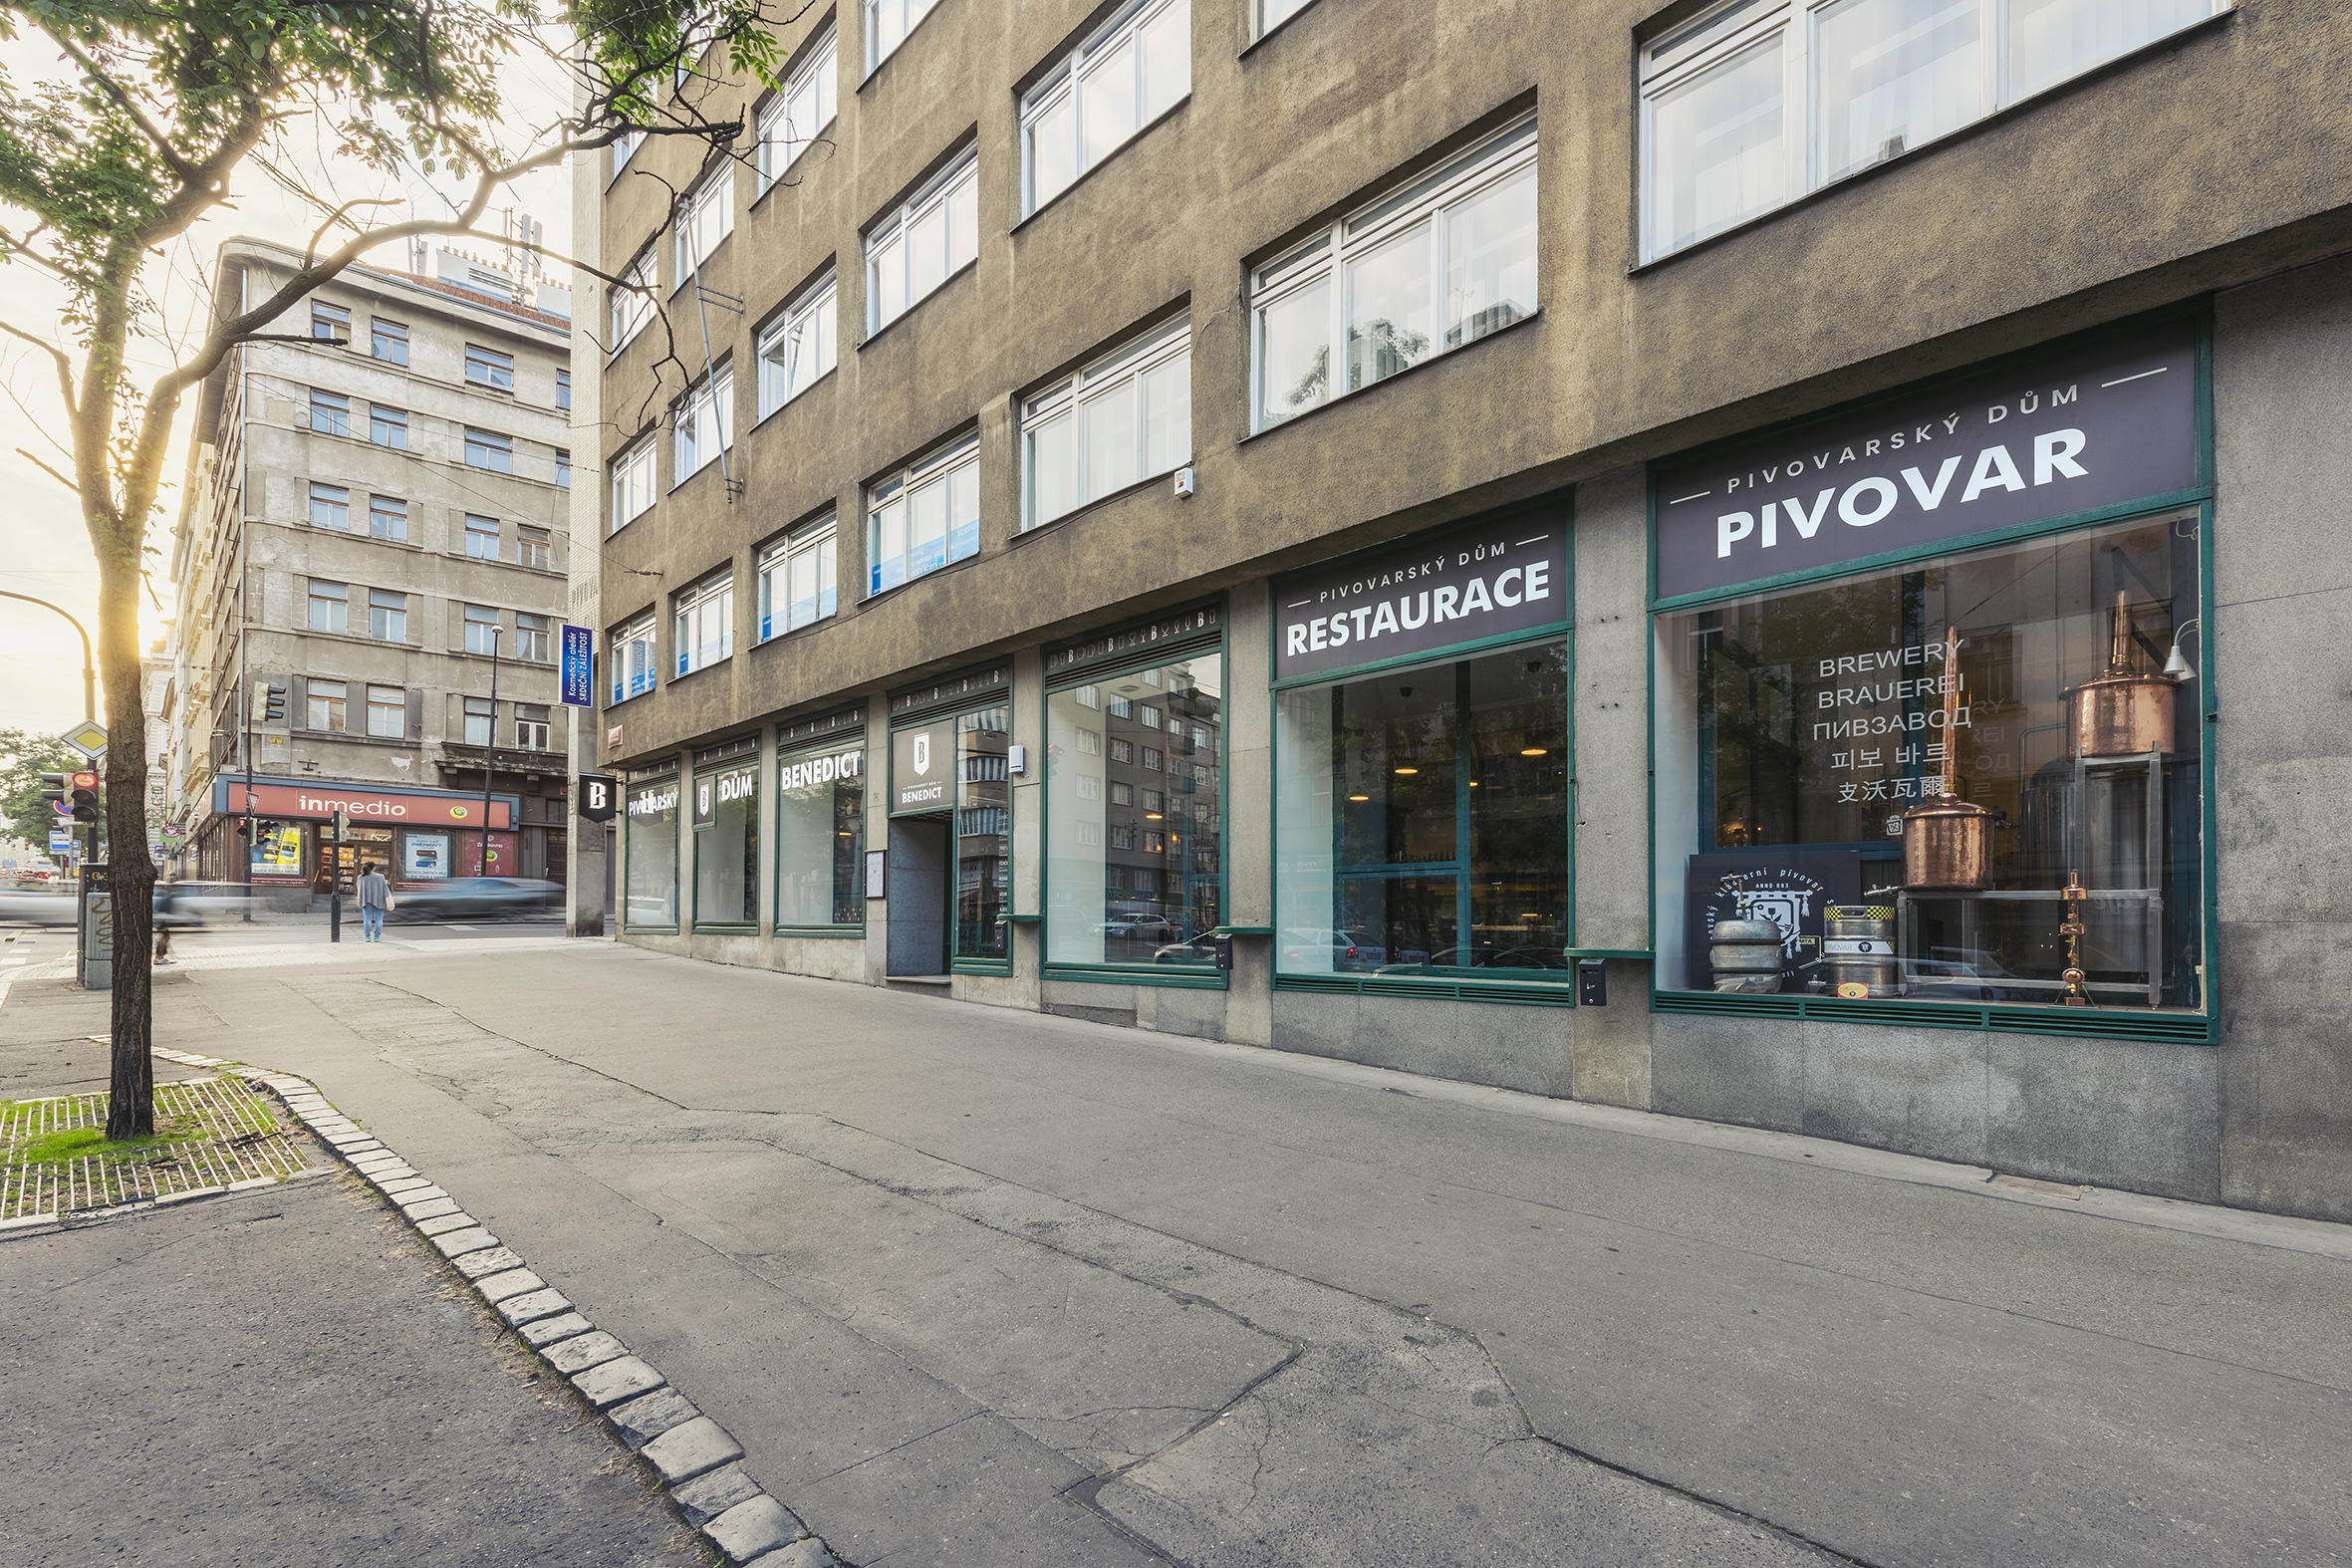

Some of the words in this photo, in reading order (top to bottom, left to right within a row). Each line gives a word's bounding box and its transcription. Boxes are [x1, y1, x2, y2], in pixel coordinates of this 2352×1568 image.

[1727, 412, 1960, 494] PIVOVARSKÝ
[1987, 384, 2080, 424] DŮM
[1716, 426, 2090, 560] PIVOVAR
[1320, 555, 1445, 604] PIVOVARSKÝ
[1458, 541, 1506, 566] DŮM
[1287, 560, 1550, 657] RESTAURACE
[568, 632, 577, 655] ateliér
[578, 632, 588, 669] ZÁLEŽITOST
[1819, 639, 1964, 677] BREWERY
[568, 655, 578, 697] Kosmetický
[578, 669, 588, 701] SRDEČNÍ
[1818, 673, 1964, 709] BRAUEREI
[1813, 706, 1972, 741] ПИВЗАВОД
[1831, 747, 1884, 771] 피보
[1895, 743, 1951, 765] 바르
[721, 770, 753, 801] DŮM
[781, 750, 861, 791] BENEDICT
[299, 795, 406, 817] inmedio
[589, 781, 606, 809] B
[903, 787, 942, 804] BENEDICT
[1779, 869, 1825, 893] pivovar
